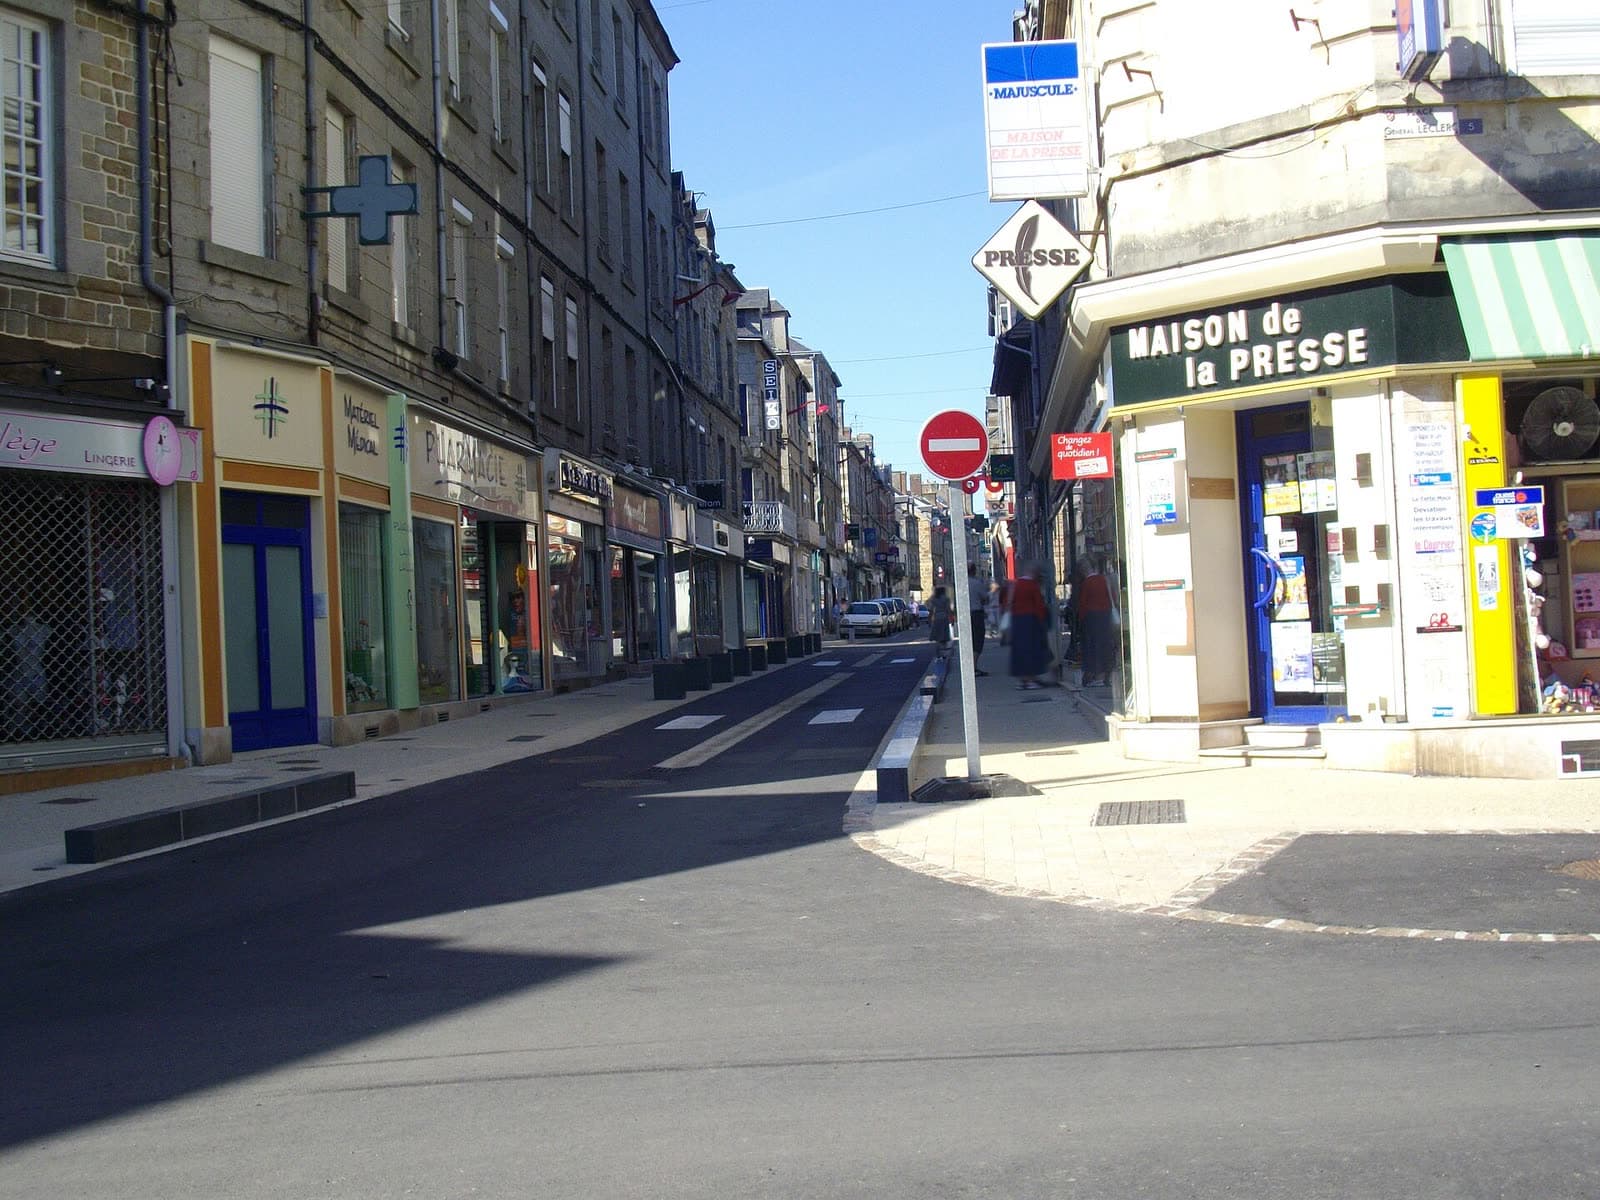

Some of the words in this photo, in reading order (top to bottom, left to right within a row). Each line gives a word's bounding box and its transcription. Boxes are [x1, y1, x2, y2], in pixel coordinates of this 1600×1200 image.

[994, 84, 1075, 100] MAJUSCULE
[1007, 130, 1064, 143] MAISON
[991, 148, 1013, 160] DE
[1011, 147, 1029, 160] LA
[1032, 145, 1082, 159] PRESSE
[984, 248, 1080, 268] PRESSE
[1128, 309, 1249, 358] MAISON
[1262, 302, 1302, 336] de
[1185, 356, 1217, 388] la
[1230, 327, 1369, 381] PRESSE
[1057, 435, 1092, 446] Changez
[84, 449, 137, 468] LINGERIE
[1057, 447, 1095, 460] quotidien
